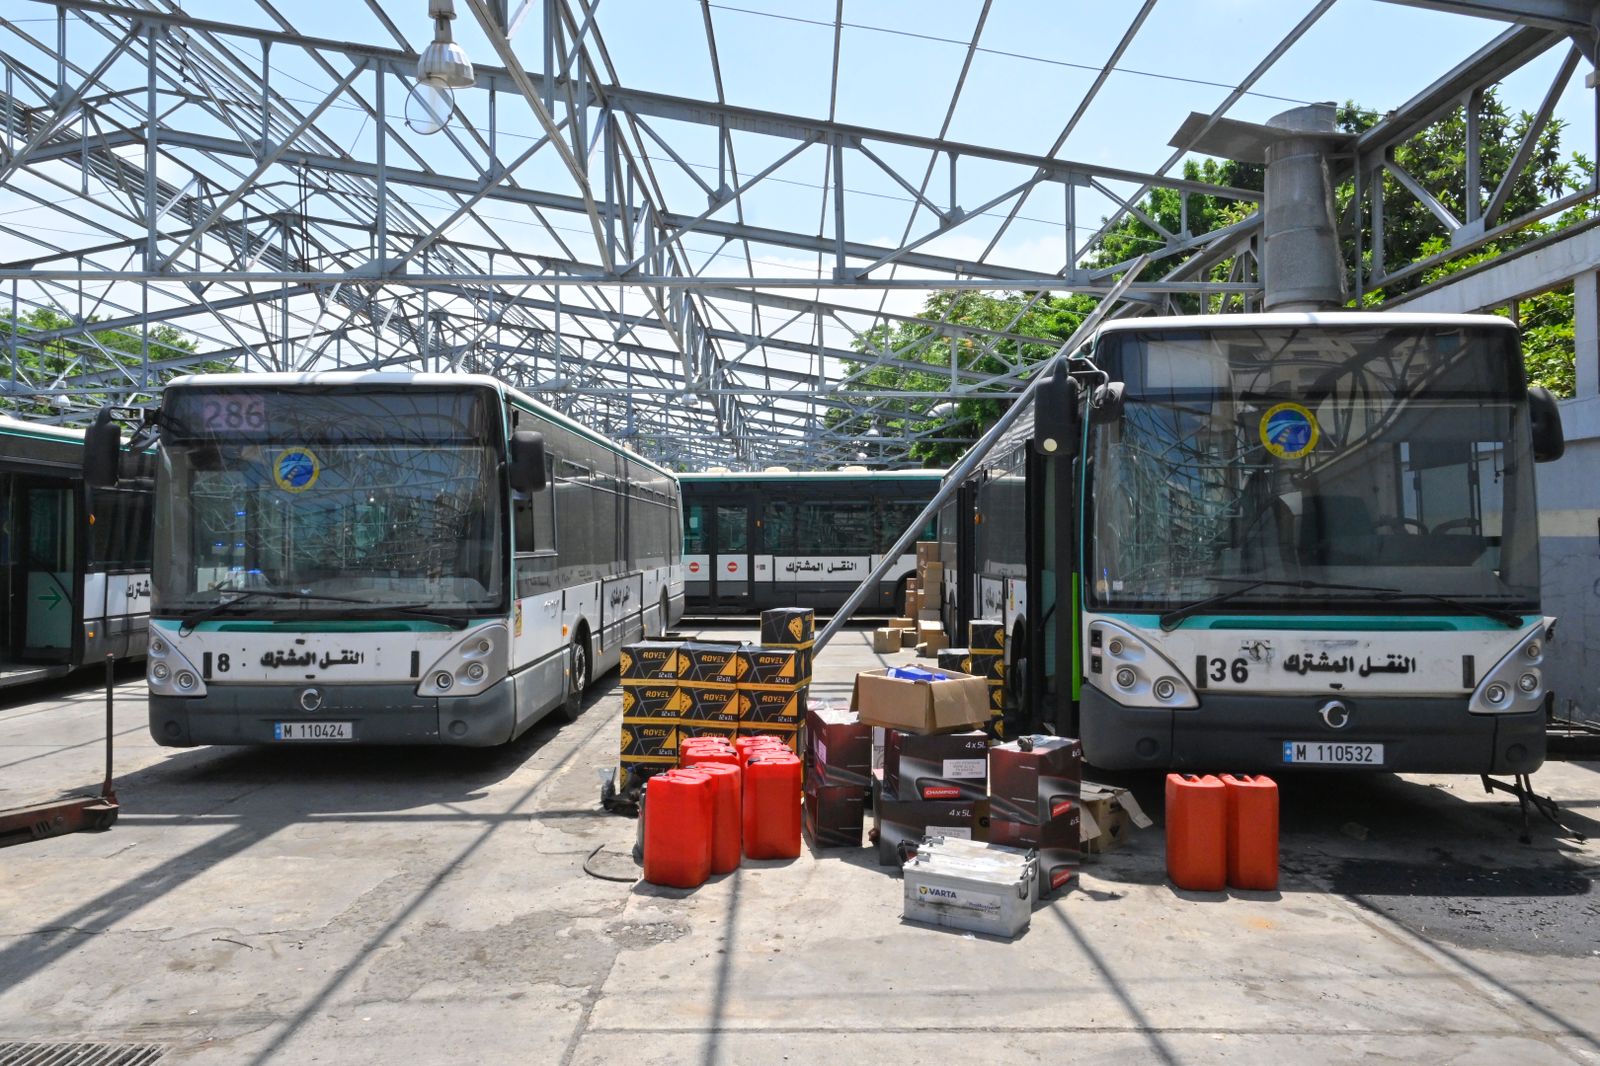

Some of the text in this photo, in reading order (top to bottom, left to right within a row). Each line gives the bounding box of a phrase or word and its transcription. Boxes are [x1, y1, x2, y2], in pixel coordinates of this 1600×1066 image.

[205, 401, 265, 428] 286
[786, 561, 857, 573] النقل المشترك
[217, 653, 230, 672] 8
[260, 649, 364, 669] النقل المشترك
[1283, 652, 1416, 677] النقل المشترك
[1210, 657, 1249, 683] 36
[284, 725, 344, 737] M 110424
[1296, 745, 1373, 762] M 110532
[929, 888, 957, 899] VARTA
